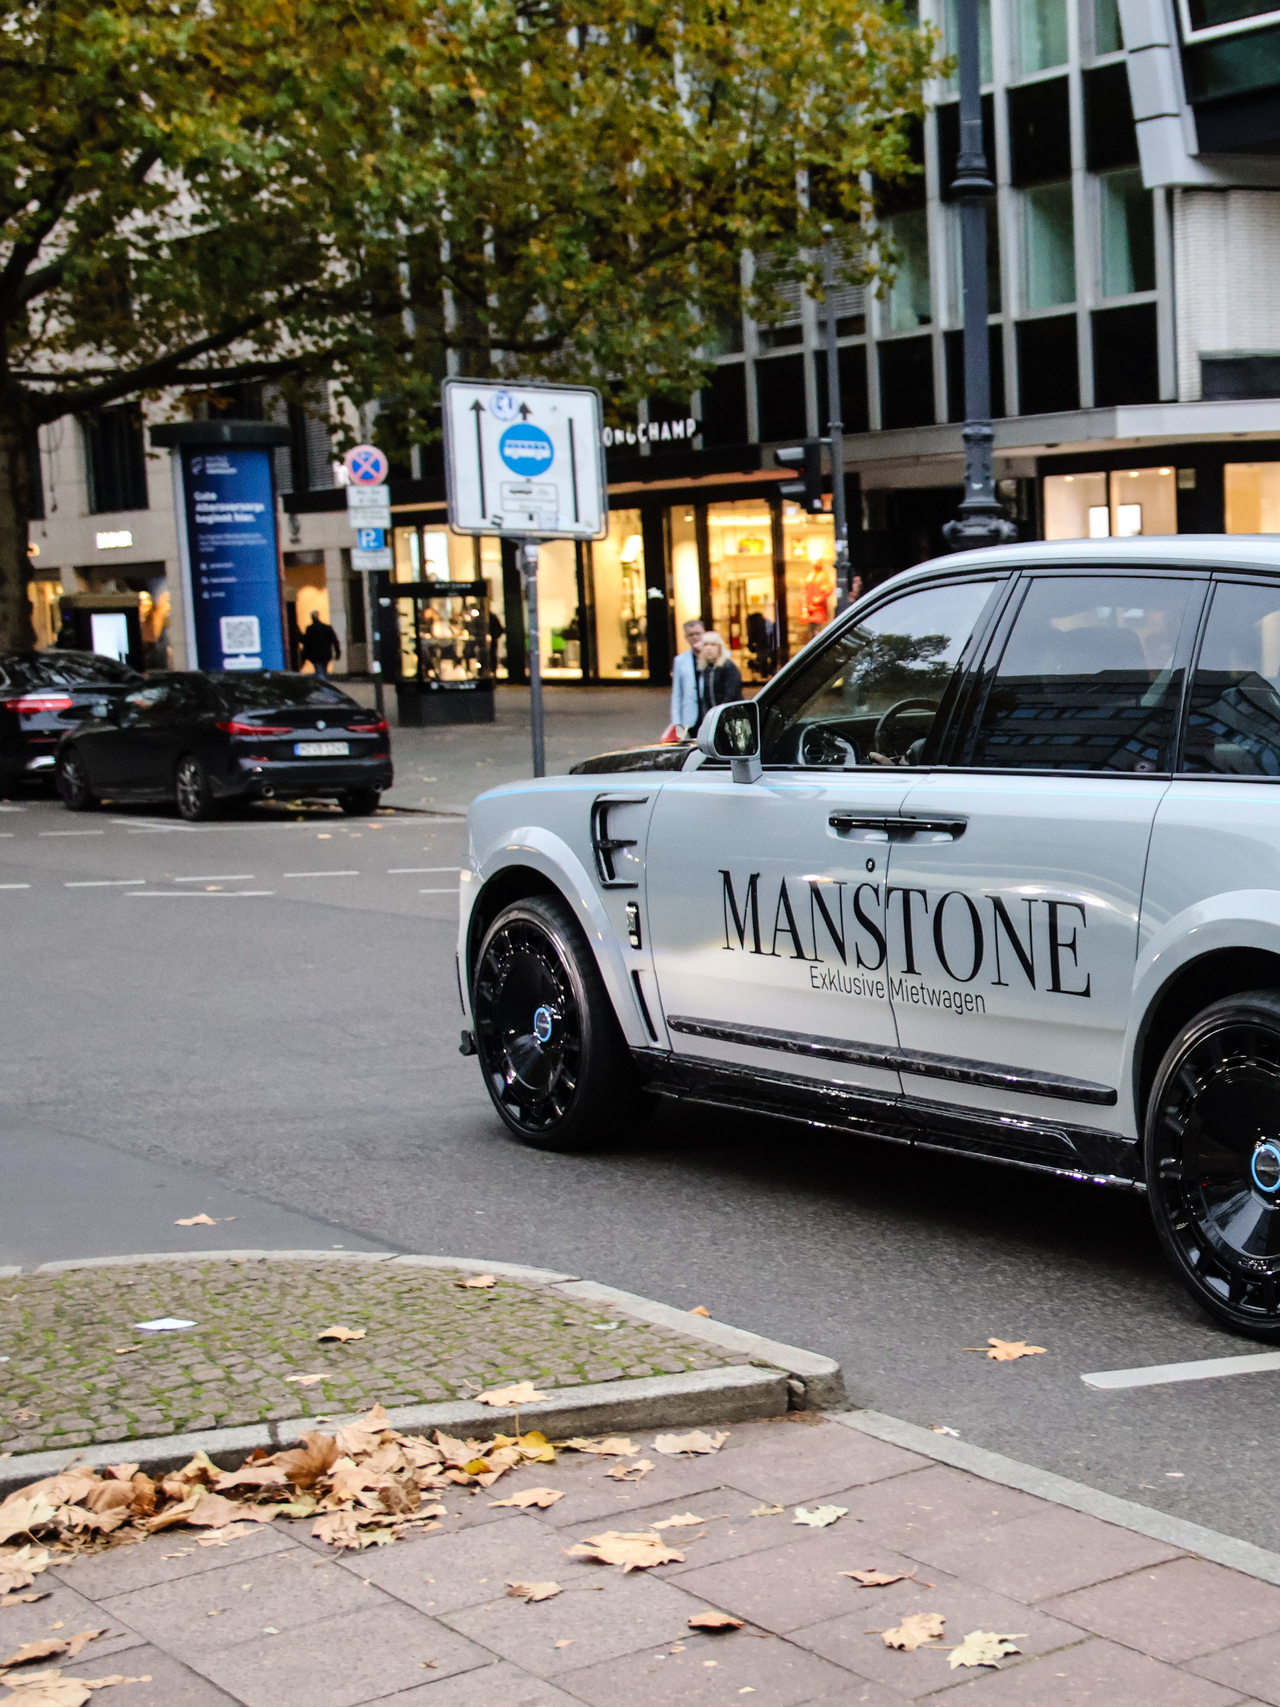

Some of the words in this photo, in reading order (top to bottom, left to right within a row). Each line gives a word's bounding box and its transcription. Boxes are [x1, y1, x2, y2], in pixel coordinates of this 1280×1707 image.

[718, 870, 1091, 998] MANSTONE
[810, 965, 885, 999] Exklusive
[890, 976, 986, 1015] Mietwagen
